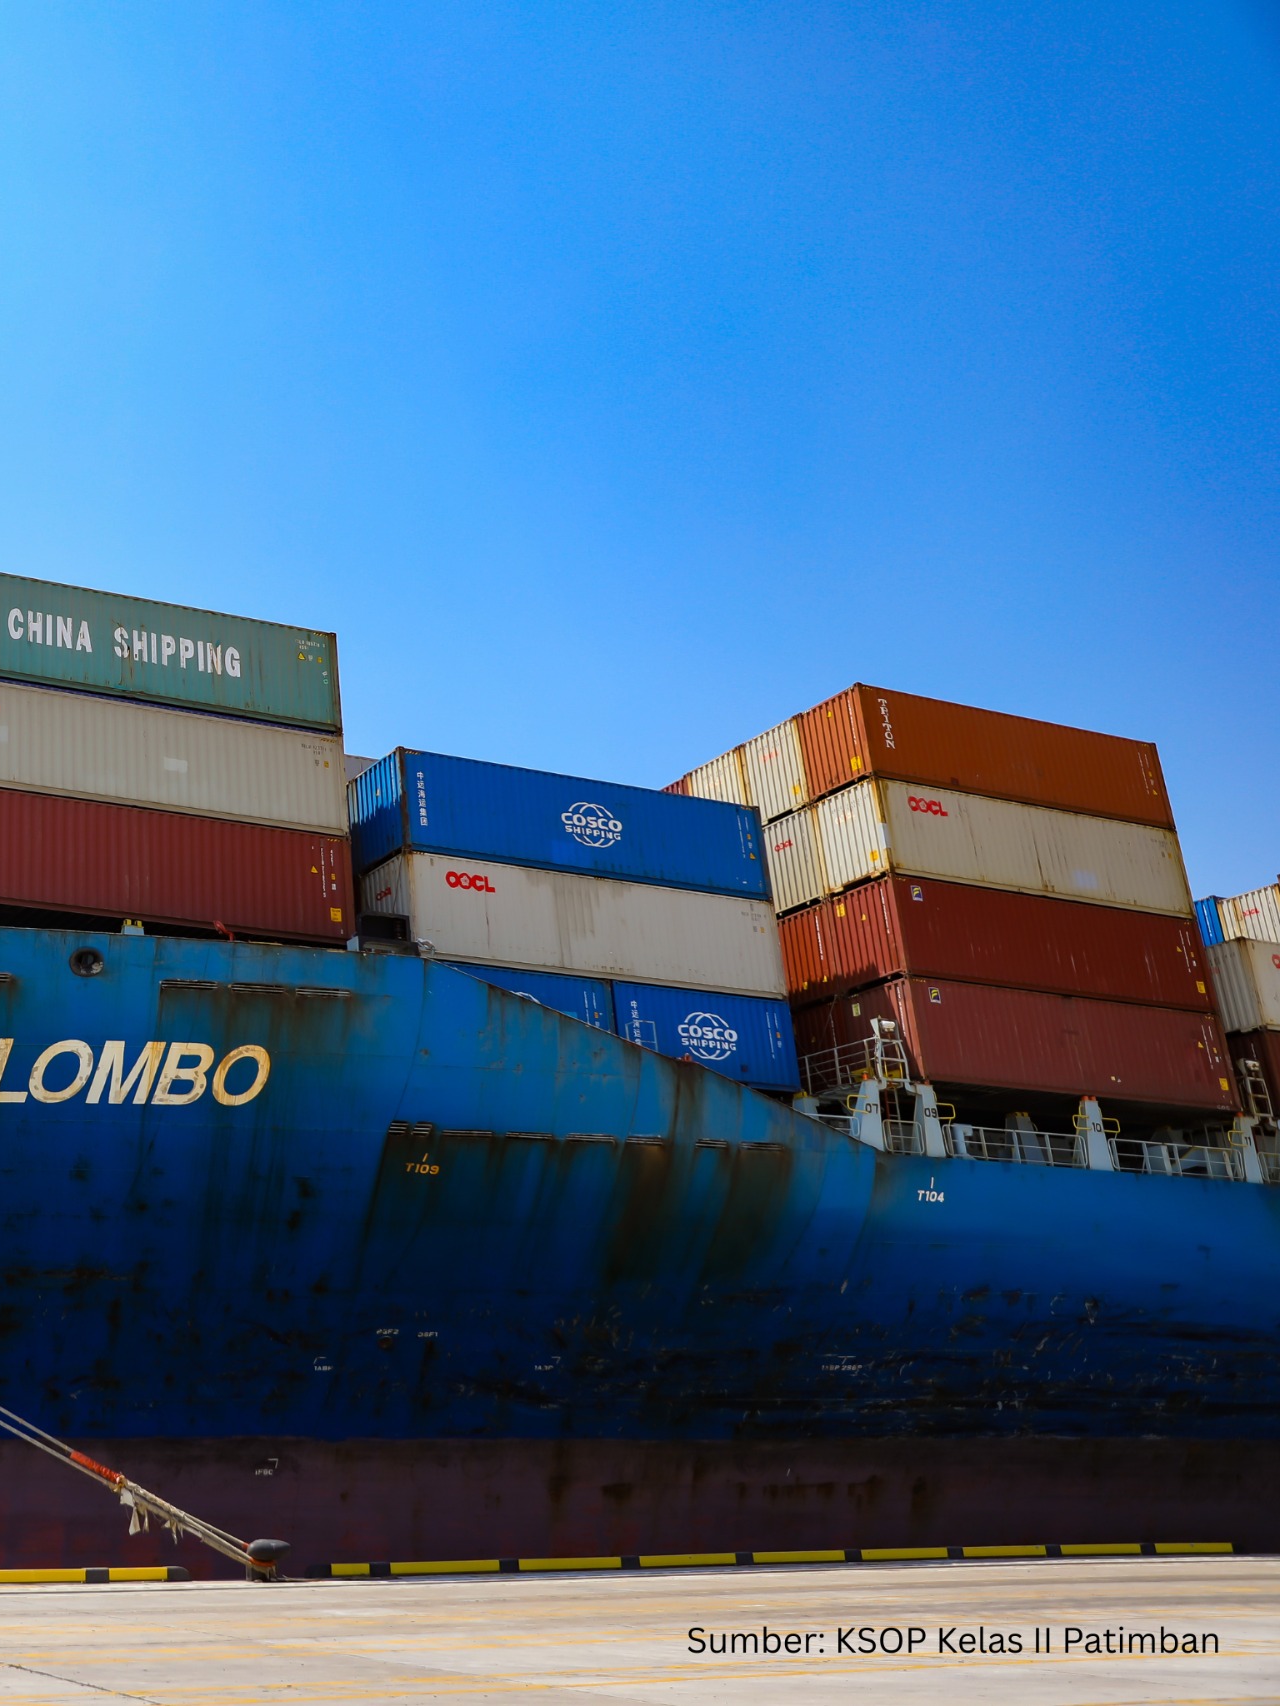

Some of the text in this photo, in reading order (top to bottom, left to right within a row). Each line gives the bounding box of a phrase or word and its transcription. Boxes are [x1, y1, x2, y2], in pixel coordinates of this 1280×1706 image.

[7, 607, 242, 679] CHINA SHIPPING
[877, 698, 896, 749] TRITON
[908, 796, 949, 817] OOCL
[561, 812, 623, 832] COSCO
[565, 825, 622, 841] SHIPPING
[445, 870, 496, 893] OOCL
[677, 1024, 738, 1042] COSCO
[681, 1037, 737, 1051] SHIPPING
[865, 1103, 879, 1114] 07
[924, 1107, 938, 1119] 09
[1091, 1122, 1102, 1133] 10
[405, 1162, 440, 1175] T109
[917, 1189, 945, 1203] T104
